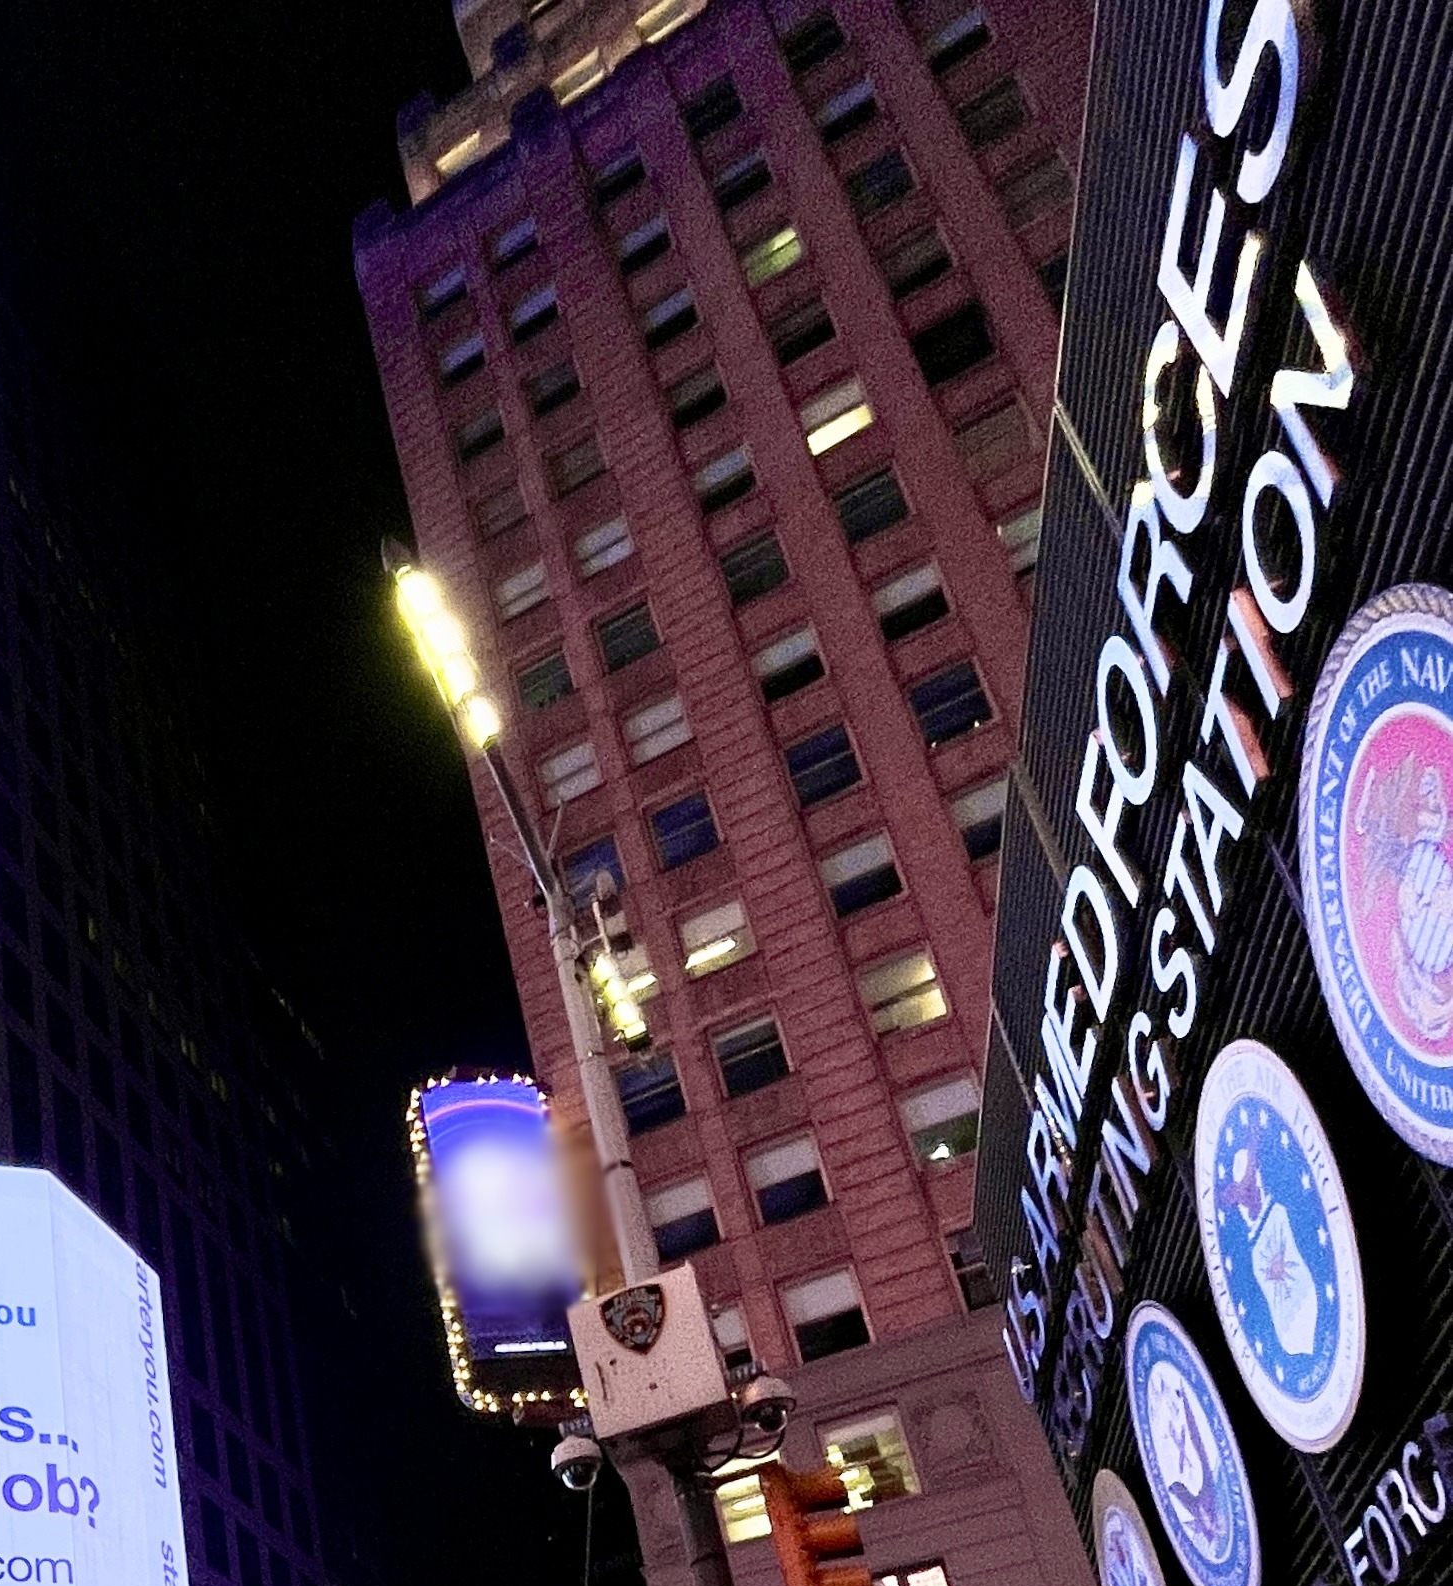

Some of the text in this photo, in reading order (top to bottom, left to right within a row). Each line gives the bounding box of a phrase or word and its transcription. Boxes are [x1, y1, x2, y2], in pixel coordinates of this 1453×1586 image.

[1021, 865, 1118, 1300] ARMED
[1075, 0, 1301, 907] FORCES
[1151, 259, 1354, 1039] STATION
[1356, 658, 1393, 708] THE
